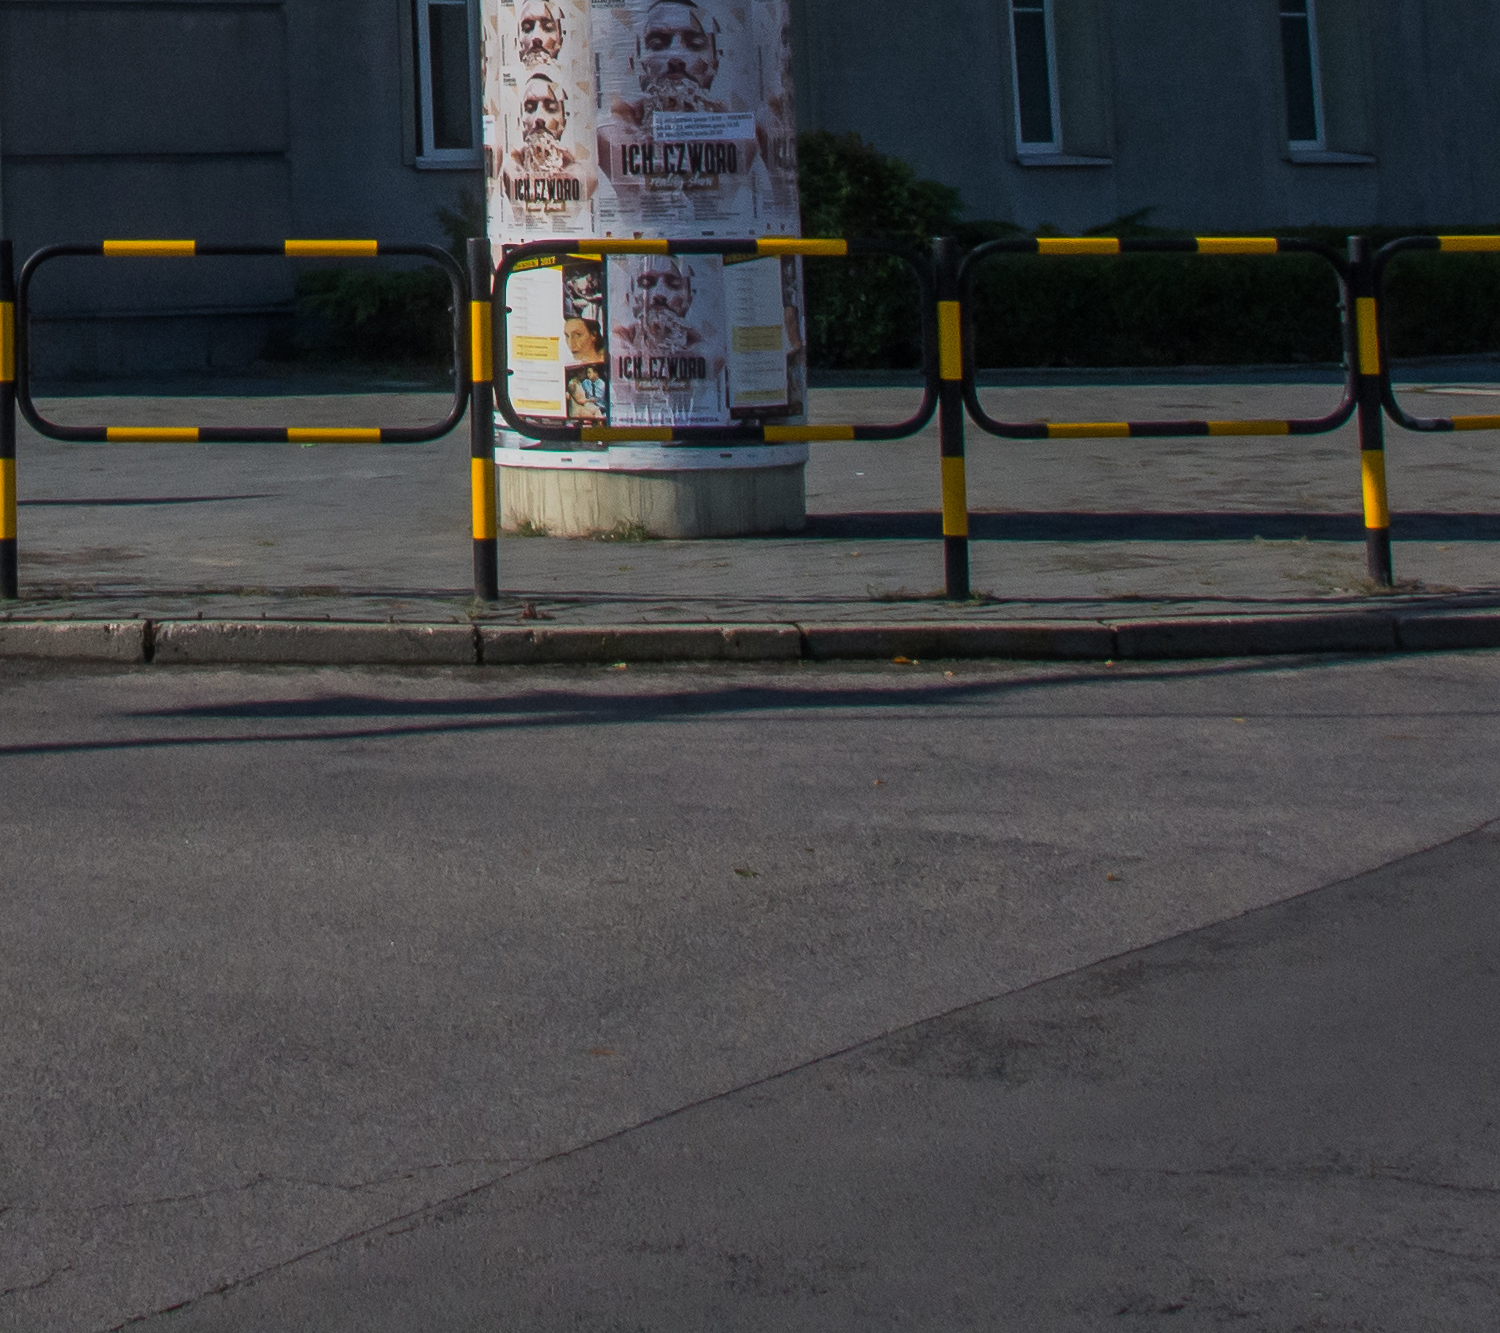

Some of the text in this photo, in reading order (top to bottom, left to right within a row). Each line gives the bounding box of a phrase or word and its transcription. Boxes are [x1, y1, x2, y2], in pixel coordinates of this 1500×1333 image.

[620, 143, 654, 176] ICH
[663, 142, 738, 175] CZWORO
[514, 178, 580, 201] ICH CZWORO
[618, 355, 706, 380] ICH CZWORO
